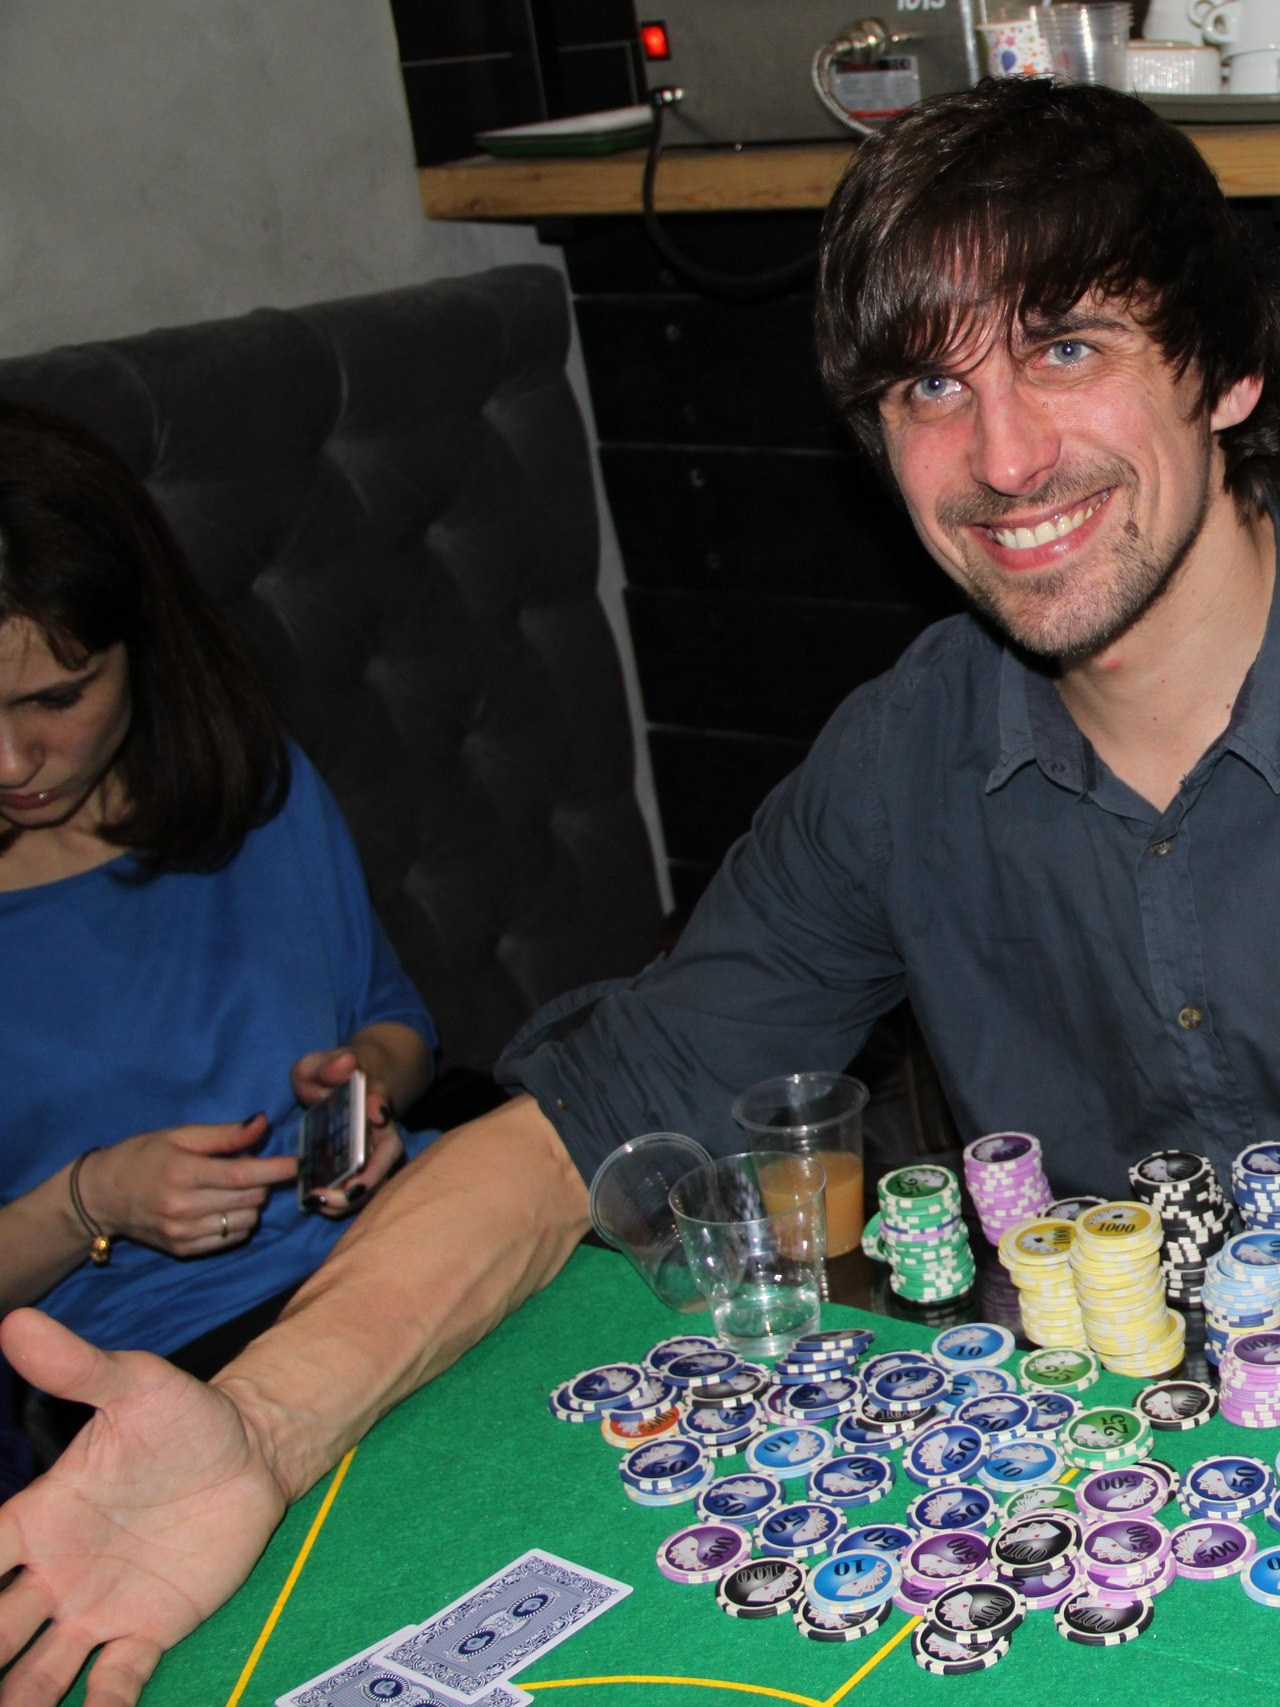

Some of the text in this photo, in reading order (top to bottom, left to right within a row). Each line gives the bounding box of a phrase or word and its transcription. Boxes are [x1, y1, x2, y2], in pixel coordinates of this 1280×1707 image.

[897, 1177, 921, 1194] 25
[1053, 1226, 1072, 1245] 1000
[1097, 1222, 1136, 1233] 1000
[955, 1345, 982, 1356] 10
[1240, 1336, 1279, 1351] 500
[884, 1370, 921, 1384] 50
[1037, 1364, 1076, 1381] 25
[580, 1378, 604, 1397] 50
[1036, 1395, 1063, 1413] 50
[1177, 1391, 1206, 1414] 100
[975, 1414, 1009, 1431] 50
[1101, 1413, 1129, 1437] 25
[764, 1436, 793, 1453] 10
[944, 1437, 979, 1464] 50
[651, 1460, 688, 1474] 50
[848, 1458, 878, 1480] 50
[993, 1460, 1023, 1478] 10
[1231, 1465, 1259, 1488] 50
[1096, 1475, 1137, 1491] 500
[712, 1494, 747, 1514] 50
[946, 1502, 986, 1523] 50
[766, 1511, 805, 1534] 50
[863, 1528, 900, 1549] 50
[1126, 1525, 1154, 1550] 500
[702, 1536, 736, 1562] 500
[947, 1537, 979, 1562] 500
[1002, 1543, 1048, 1562] 100
[1198, 1540, 1239, 1563] 500
[736, 1563, 781, 1584] 100
[834, 1558, 866, 1577] 10
[972, 1595, 1011, 1626] 100
[1070, 1608, 1117, 1631] 100
